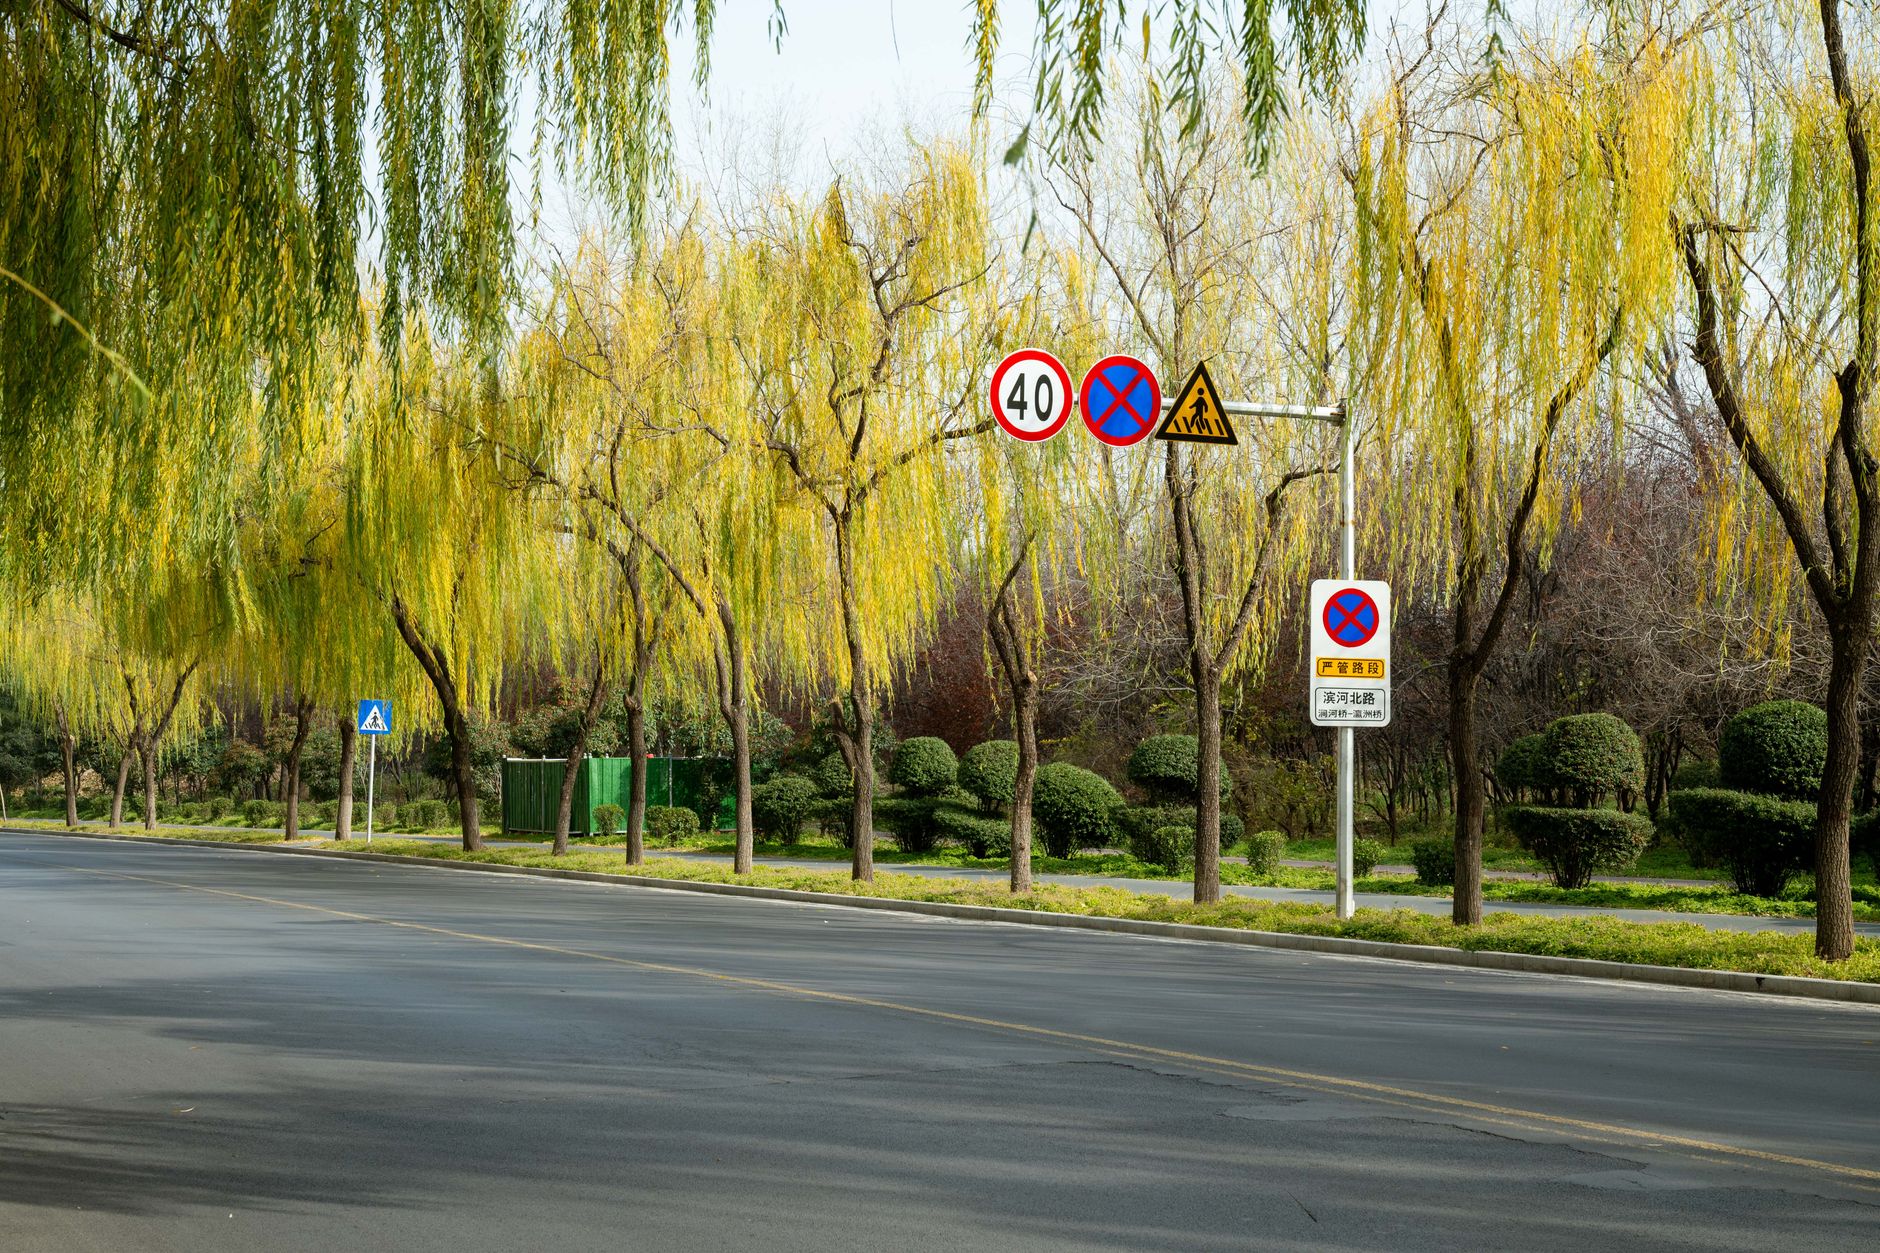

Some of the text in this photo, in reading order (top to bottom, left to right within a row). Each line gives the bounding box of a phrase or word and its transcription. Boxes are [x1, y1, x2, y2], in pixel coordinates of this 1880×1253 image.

[1006, 372, 1053, 422] 40
[1321, 661, 1379, 675] 严管路段
[1323, 691, 1375, 705] 滨河北路
